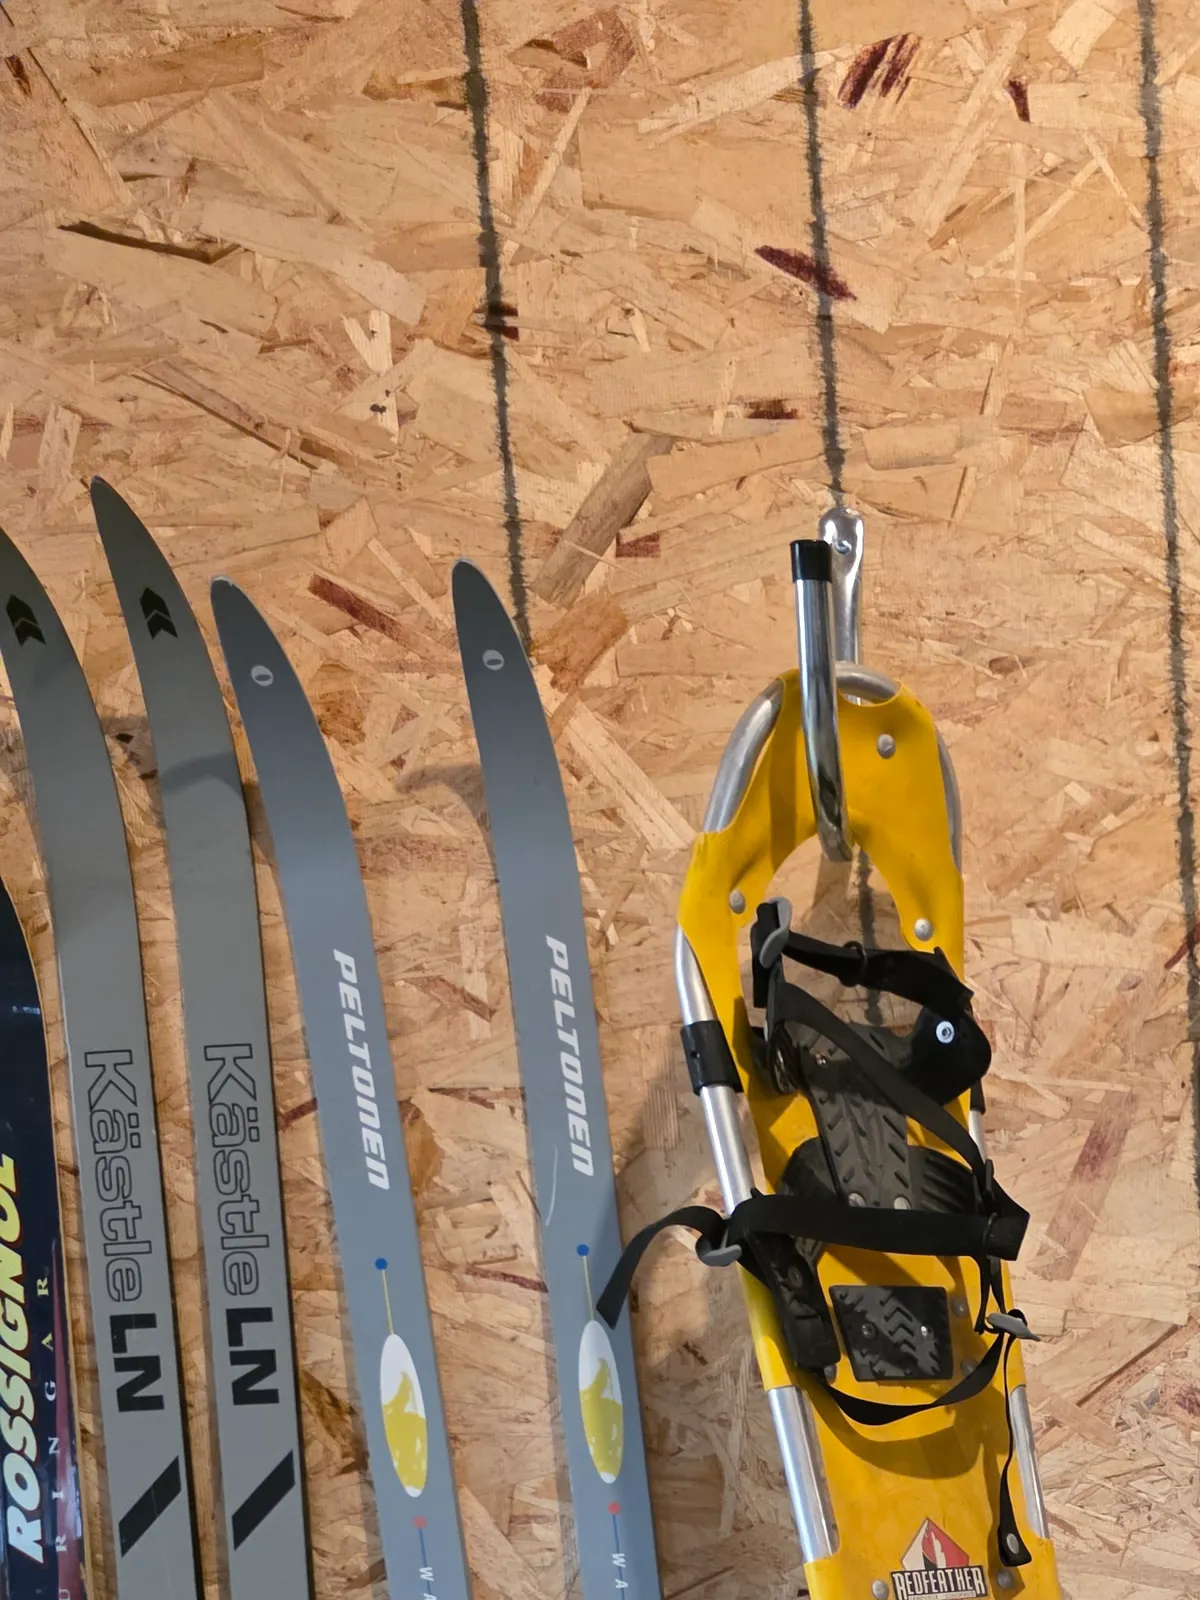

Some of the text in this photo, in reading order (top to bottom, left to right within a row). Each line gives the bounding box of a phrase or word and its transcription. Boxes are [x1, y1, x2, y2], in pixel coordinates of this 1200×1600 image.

[333, 948, 391, 1190] PELTONEN
[545, 935, 595, 1176] PELTONEN
[84, 1049, 165, 1412] Kästle LN
[203, 1043, 280, 1406] Kästle LN
[892, 1567, 986, 1600] REDFEATHER
